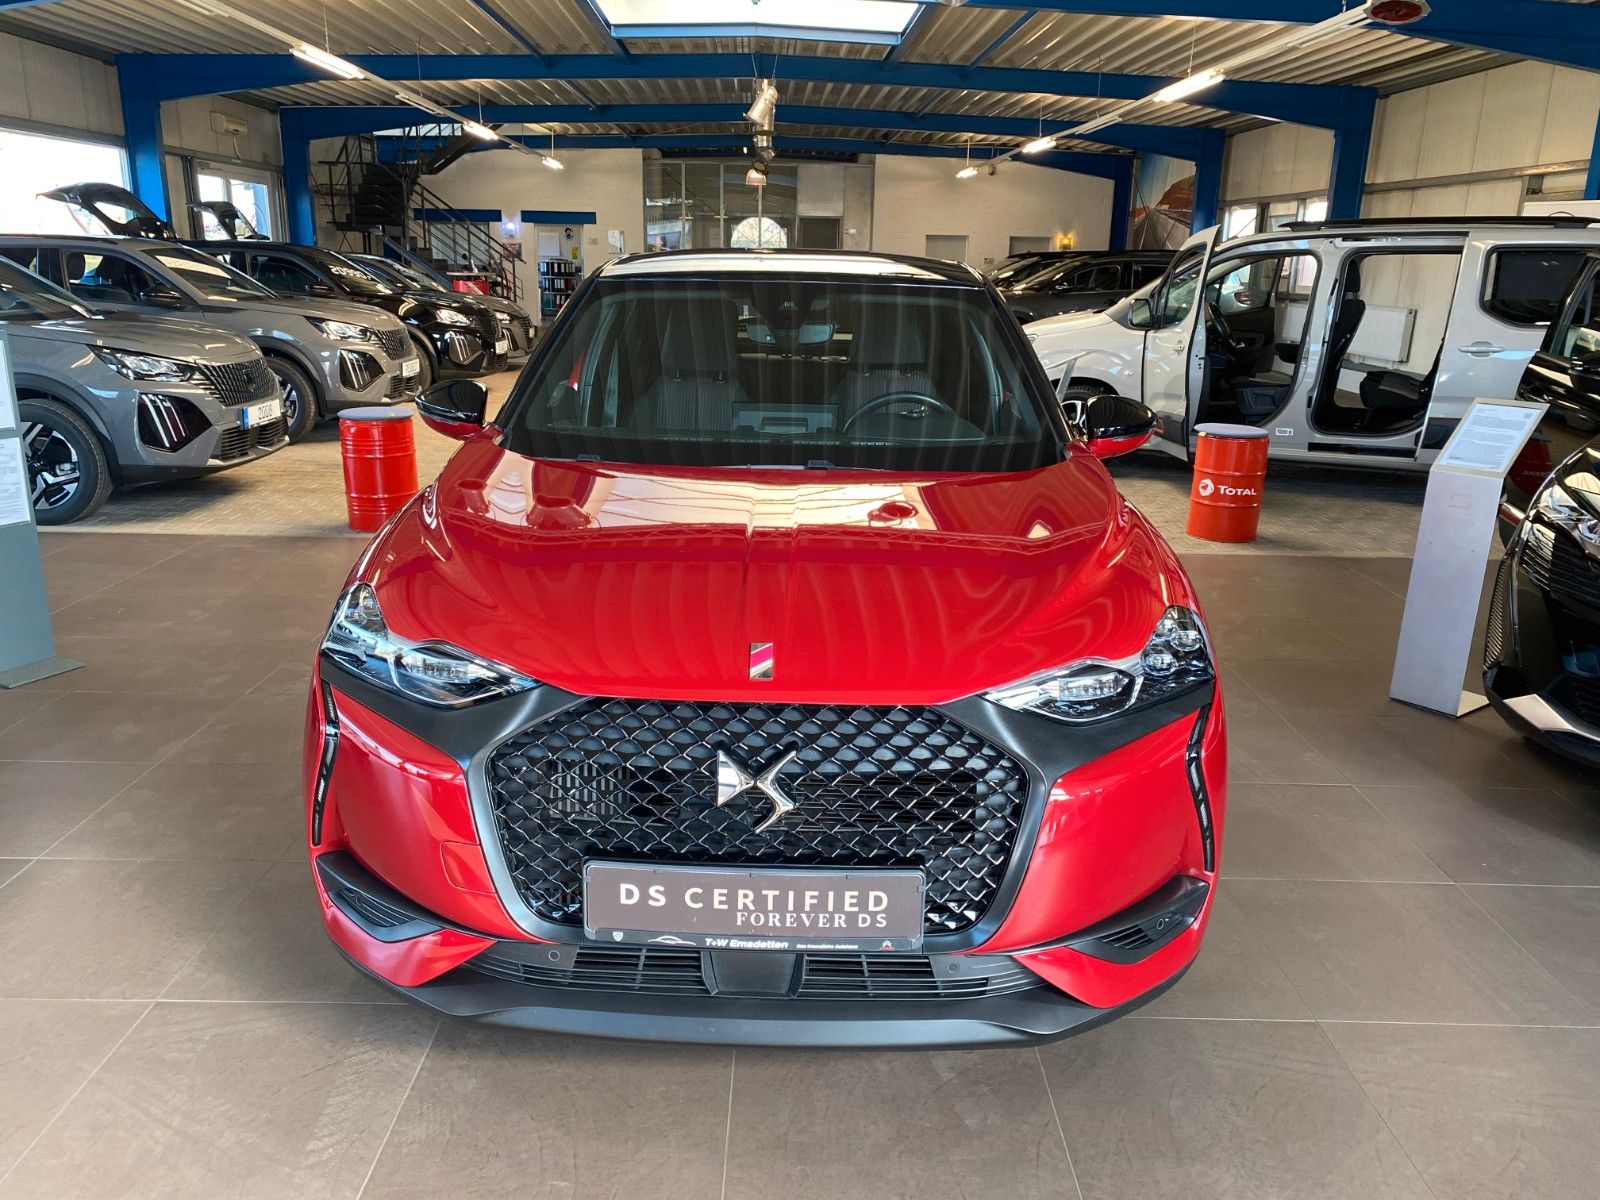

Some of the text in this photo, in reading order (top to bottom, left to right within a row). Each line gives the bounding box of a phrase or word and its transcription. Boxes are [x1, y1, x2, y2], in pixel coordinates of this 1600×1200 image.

[1218, 485, 1257, 496] TOTAL
[619, 883, 889, 912] DS CERTIFIED
[736, 911, 888, 928] FOREVER DS
